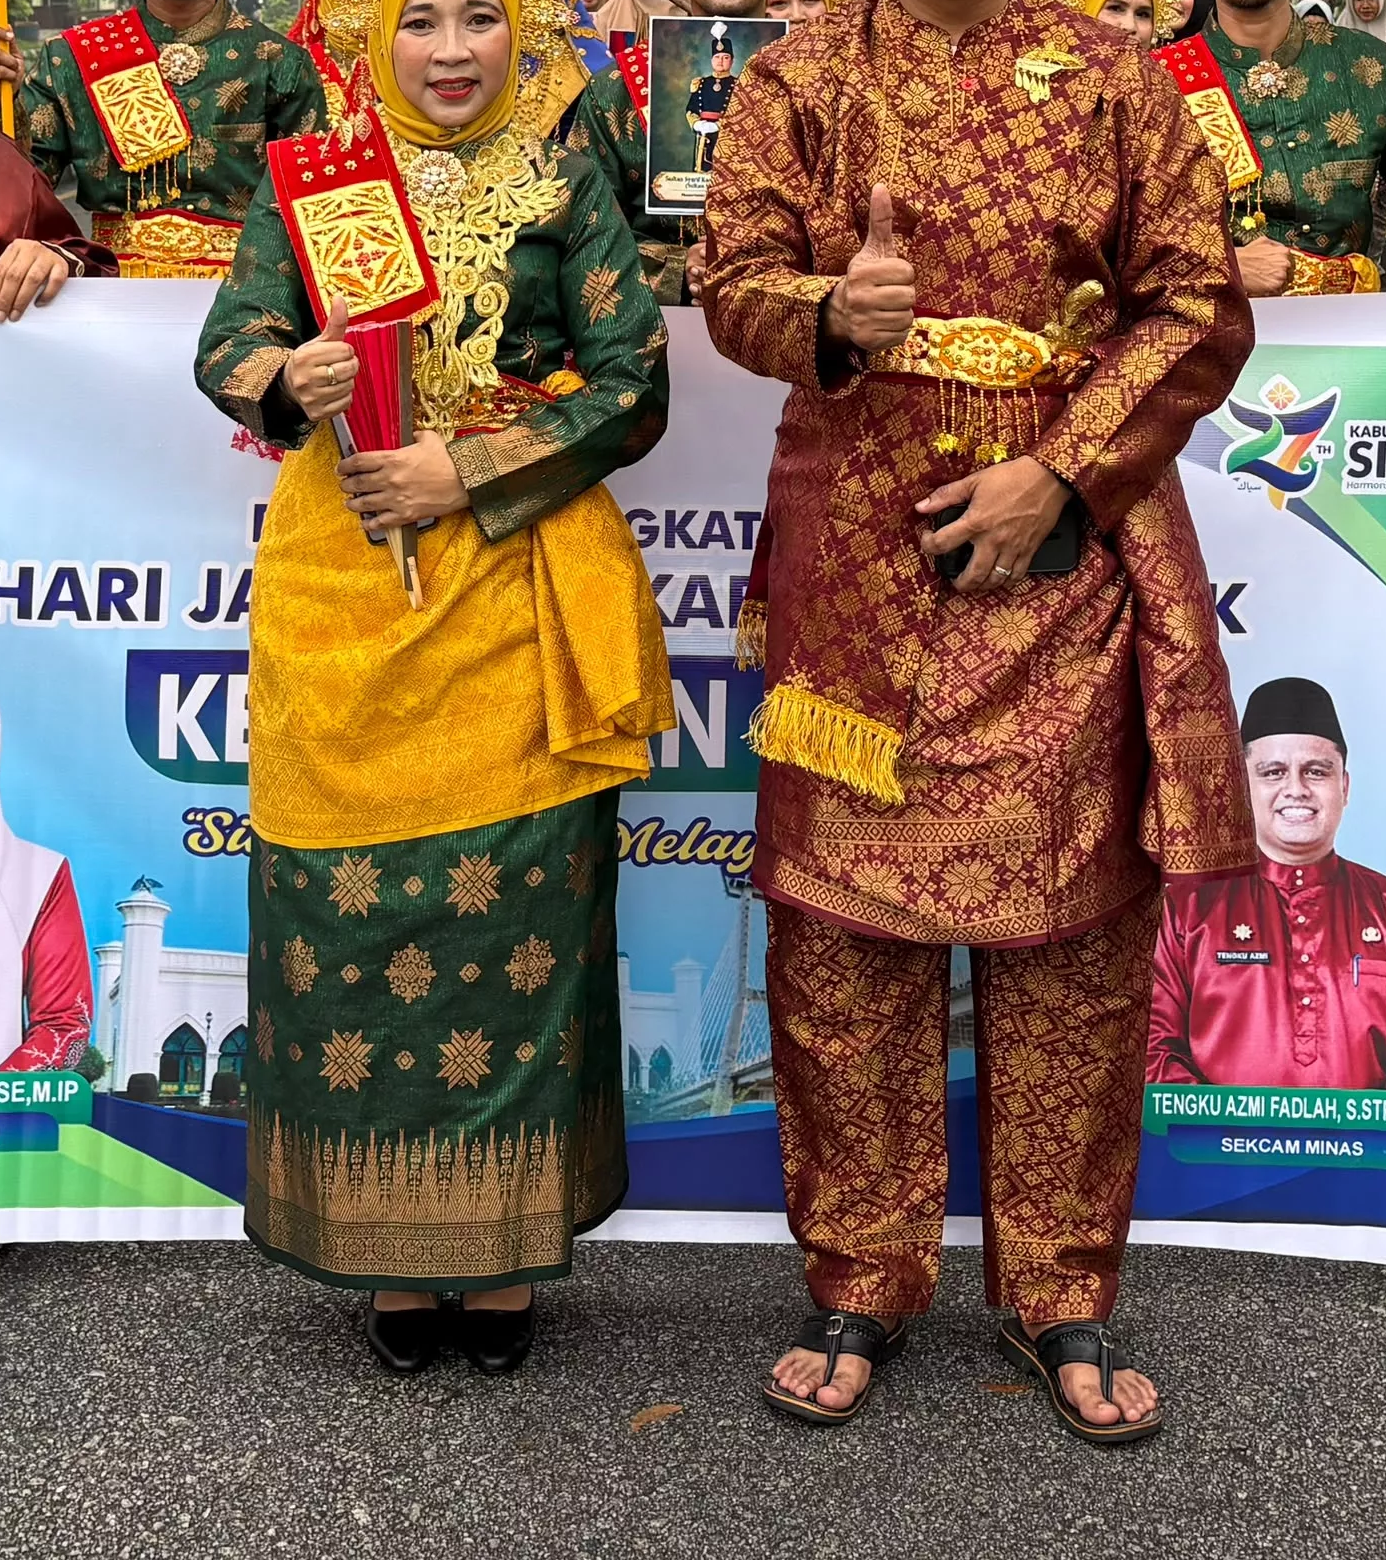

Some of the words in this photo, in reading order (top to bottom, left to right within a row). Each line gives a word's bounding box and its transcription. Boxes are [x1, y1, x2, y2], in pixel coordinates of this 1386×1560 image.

[1152, 1093, 1222, 1116] TENGKU
[1225, 1095, 1265, 1117] AZMI
[1271, 1097, 1341, 1124] FADLAH,
[1221, 1137, 1300, 1154] SEKCAM
[1306, 1140, 1364, 1157] MINAS
